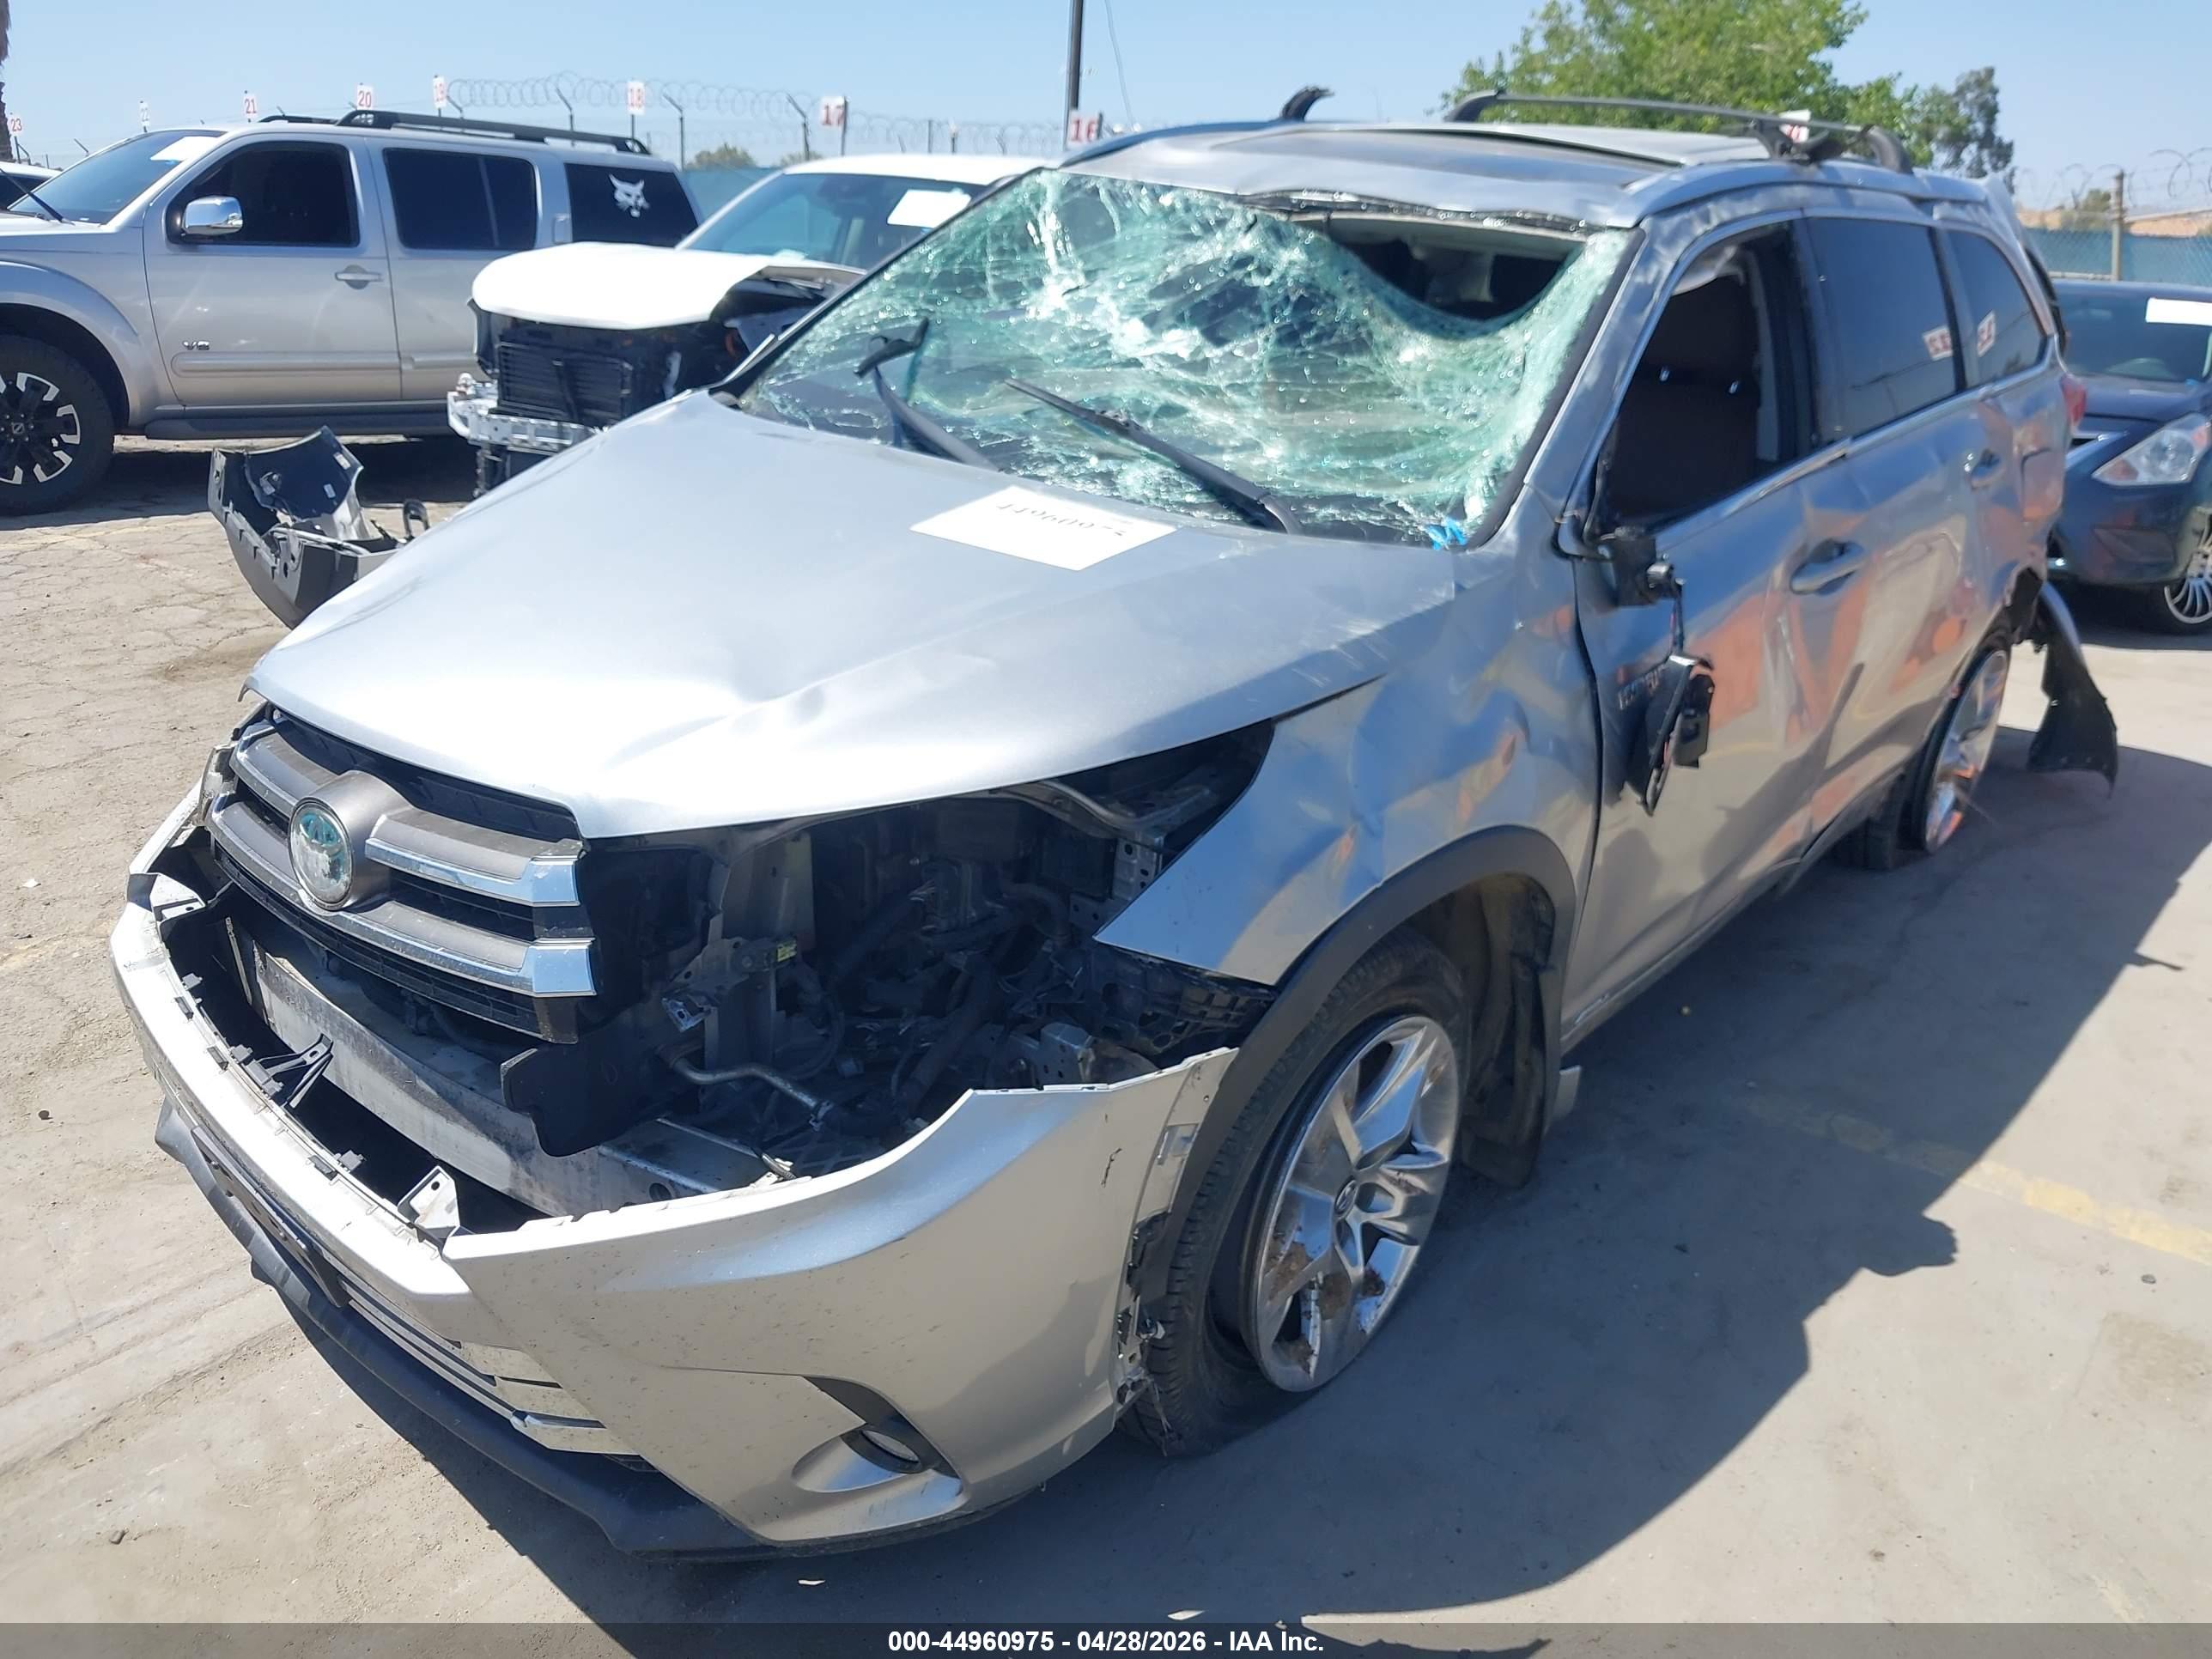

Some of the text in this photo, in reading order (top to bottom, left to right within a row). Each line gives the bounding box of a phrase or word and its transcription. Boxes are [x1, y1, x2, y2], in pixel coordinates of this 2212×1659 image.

[244, 98, 257, 114] 21
[358, 89, 372, 108] 20
[10, 118, 22, 132] 23
[823, 105, 845, 126] 17
[1071, 118, 1097, 143] 16
